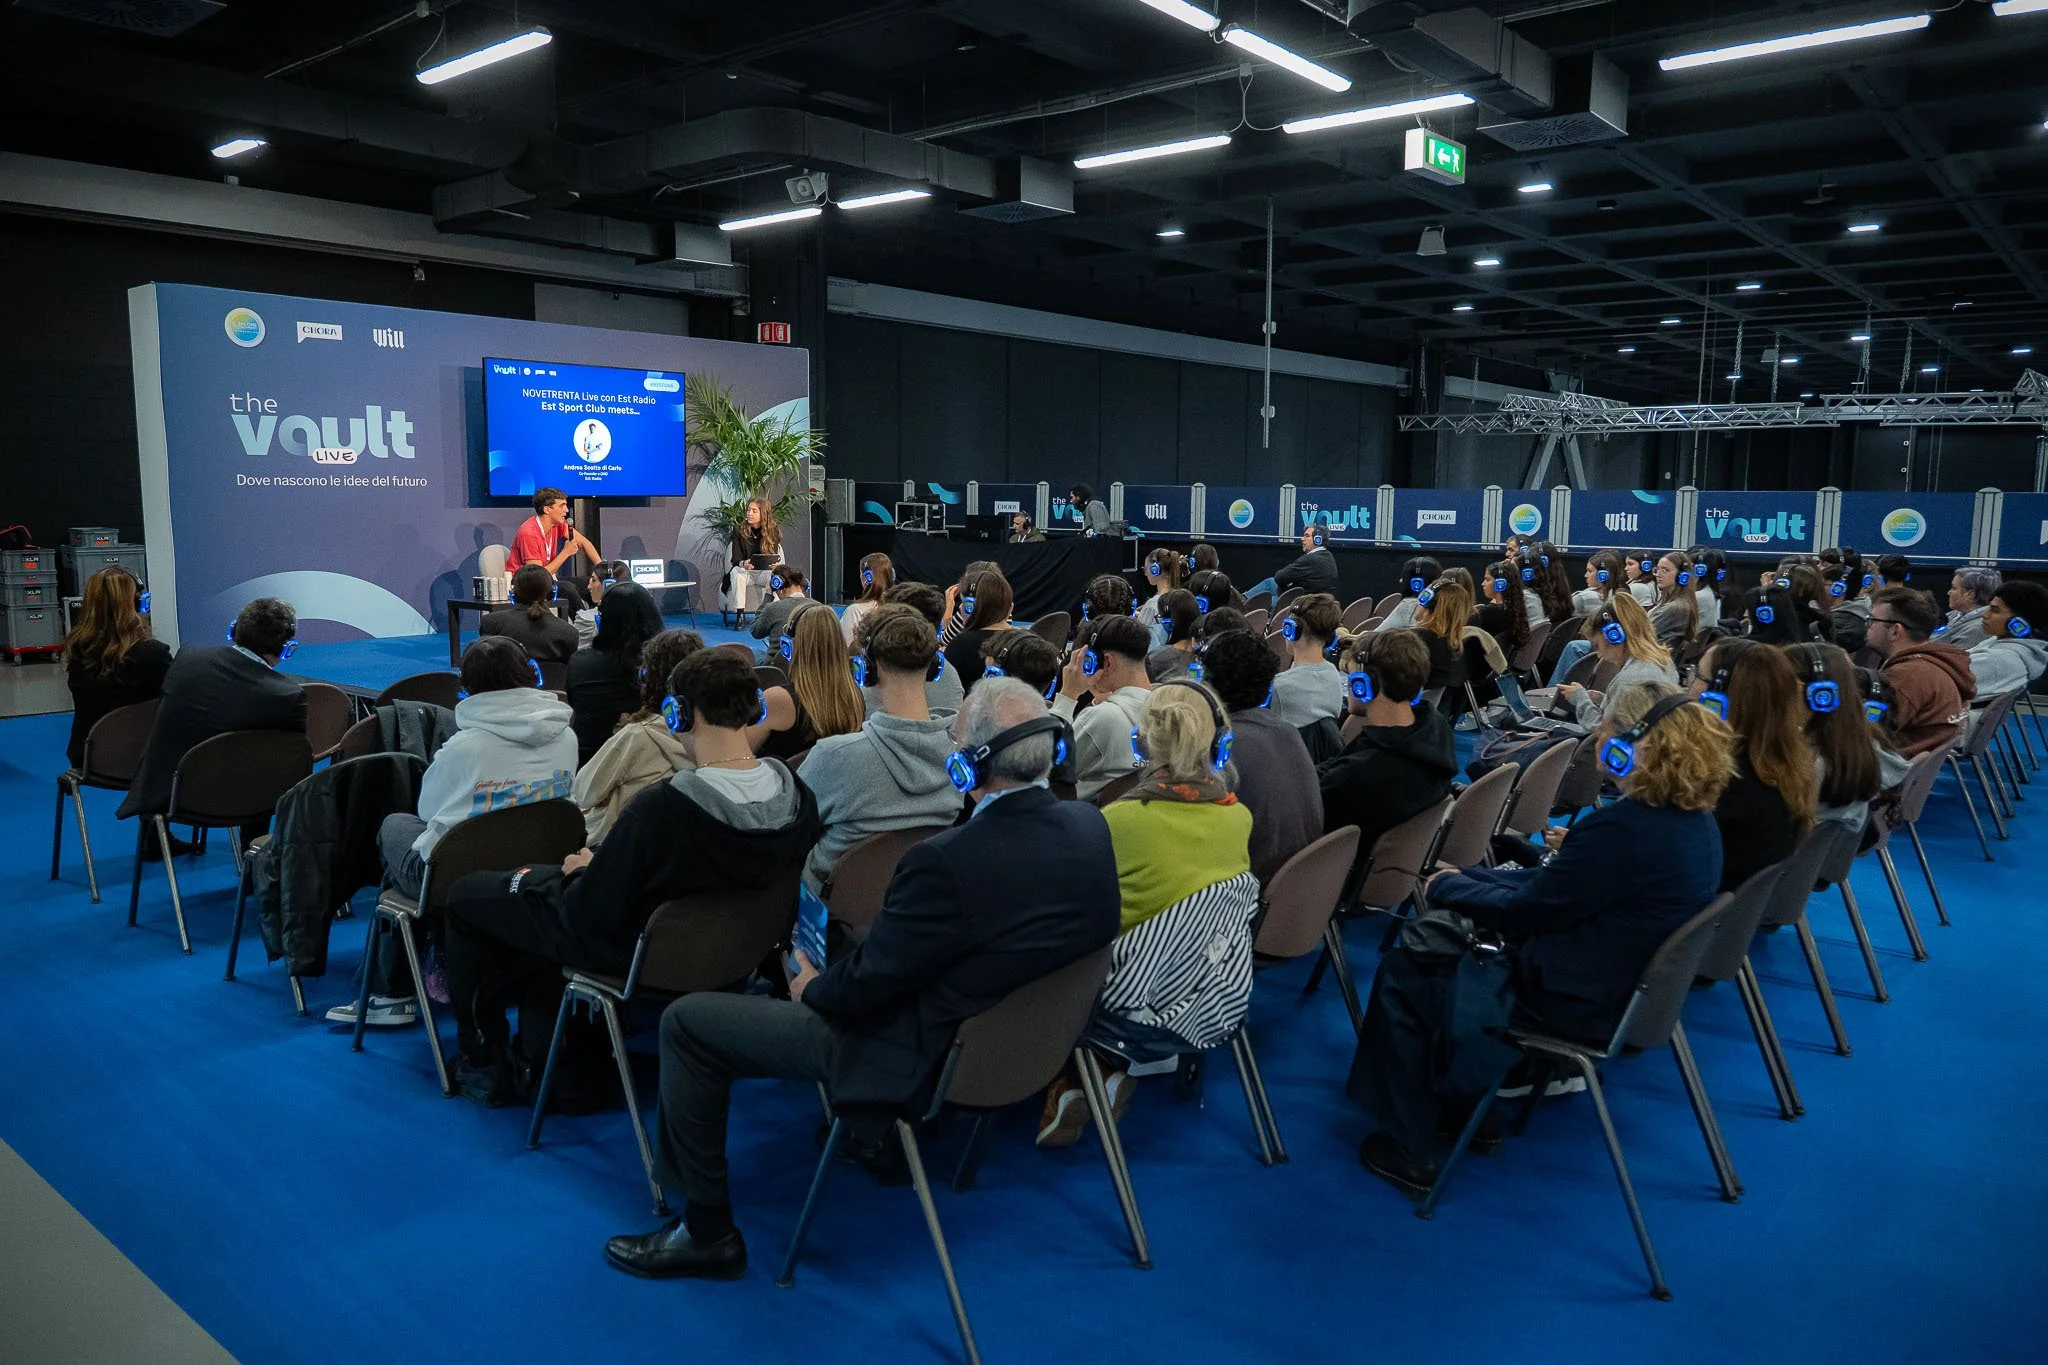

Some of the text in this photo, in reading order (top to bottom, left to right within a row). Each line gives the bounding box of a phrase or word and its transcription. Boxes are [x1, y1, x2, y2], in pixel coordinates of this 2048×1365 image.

[302, 325, 337, 336] CHORA
[229, 392, 278, 413] the
[522, 388, 656, 405] NOVETRENTA Live con Est Radio
[541, 401, 556, 411] Est
[558, 402, 584, 414] Sport
[585, 403, 606, 413] Club
[231, 405, 415, 459] vault
[316, 451, 354, 462] LIVE
[236, 473, 428, 487] Dove nascono le idee del futuro
[1053, 496, 1067, 504] the
[1300, 501, 1319, 510] the
[1300, 505, 1371, 529] vault
[1422, 513, 1452, 521] CHORA
[1705, 507, 1730, 518] the
[1704, 511, 1806, 540] vault
